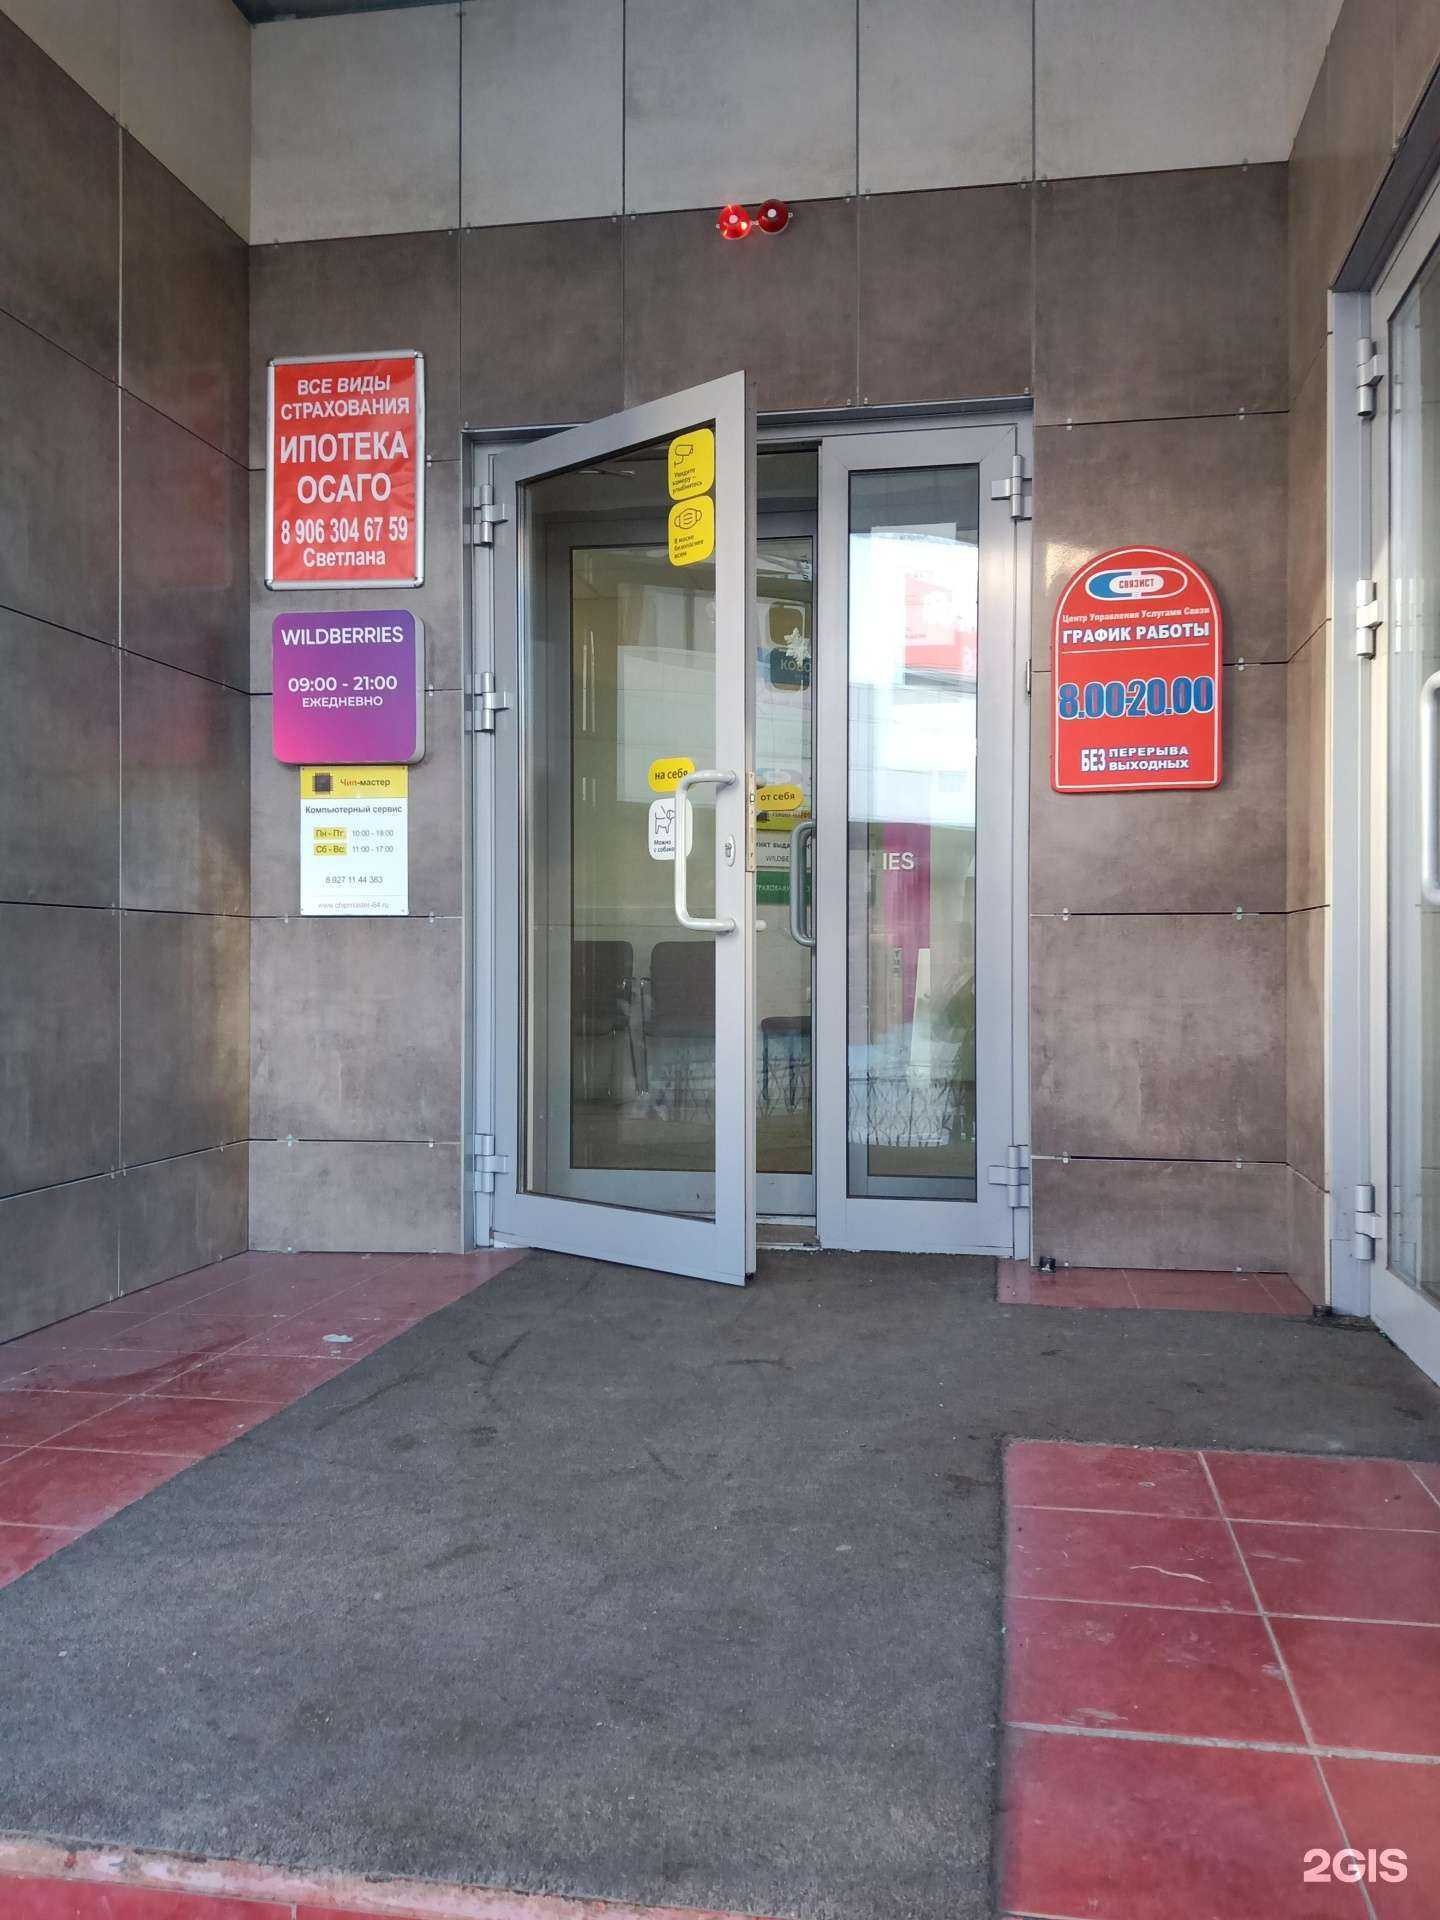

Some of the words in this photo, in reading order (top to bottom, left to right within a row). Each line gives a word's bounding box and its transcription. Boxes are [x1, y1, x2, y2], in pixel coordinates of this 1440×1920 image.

[297, 378, 332, 396] ВСЕ
[337, 374, 391, 395] ВИДЫ
[280, 397, 411, 421] СТРАХОВАНИЯ
[280, 430, 410, 464] ИПОТЕКА
[297, 472, 392, 505] ОСАГО
[281, 520, 291, 544] 8
[295, 519, 326, 544] 906
[330, 517, 360, 543] 304
[364, 516, 384, 542] 67
[388, 515, 408, 541] 59
[303, 548, 386, 567] Светлана
[1118, 578, 1155, 589] СВЯЗИСТ
[1062, 614, 1088, 624] Центр
[1090, 611, 1139, 622] Управления
[1141, 608, 1182, 620] Услугами
[281, 626, 404, 646] WILDBERRIES
[1062, 627, 1132, 644] ГРАФИК
[1136, 622, 1210, 640] РАБОТЫ
[288, 677, 337, 693] 09:00
[353, 675, 398, 691] 21:00
[302, 695, 383, 708] ЕЖЕДНЕВНО
[1081, 748, 1106, 773] БЕЗ
[1108, 746, 1189, 758] ПЕРЕРЫВА
[1108, 758, 1189, 772] ВЫХОДНЫХ
[340, 778, 391, 788] Чип-мастер
[654, 772, 666, 781] на
[760, 793, 771, 801] от
[772, 791, 796, 801] себя
[305, 805, 371, 814] Компьютерный
[372, 805, 403, 814] сервис
